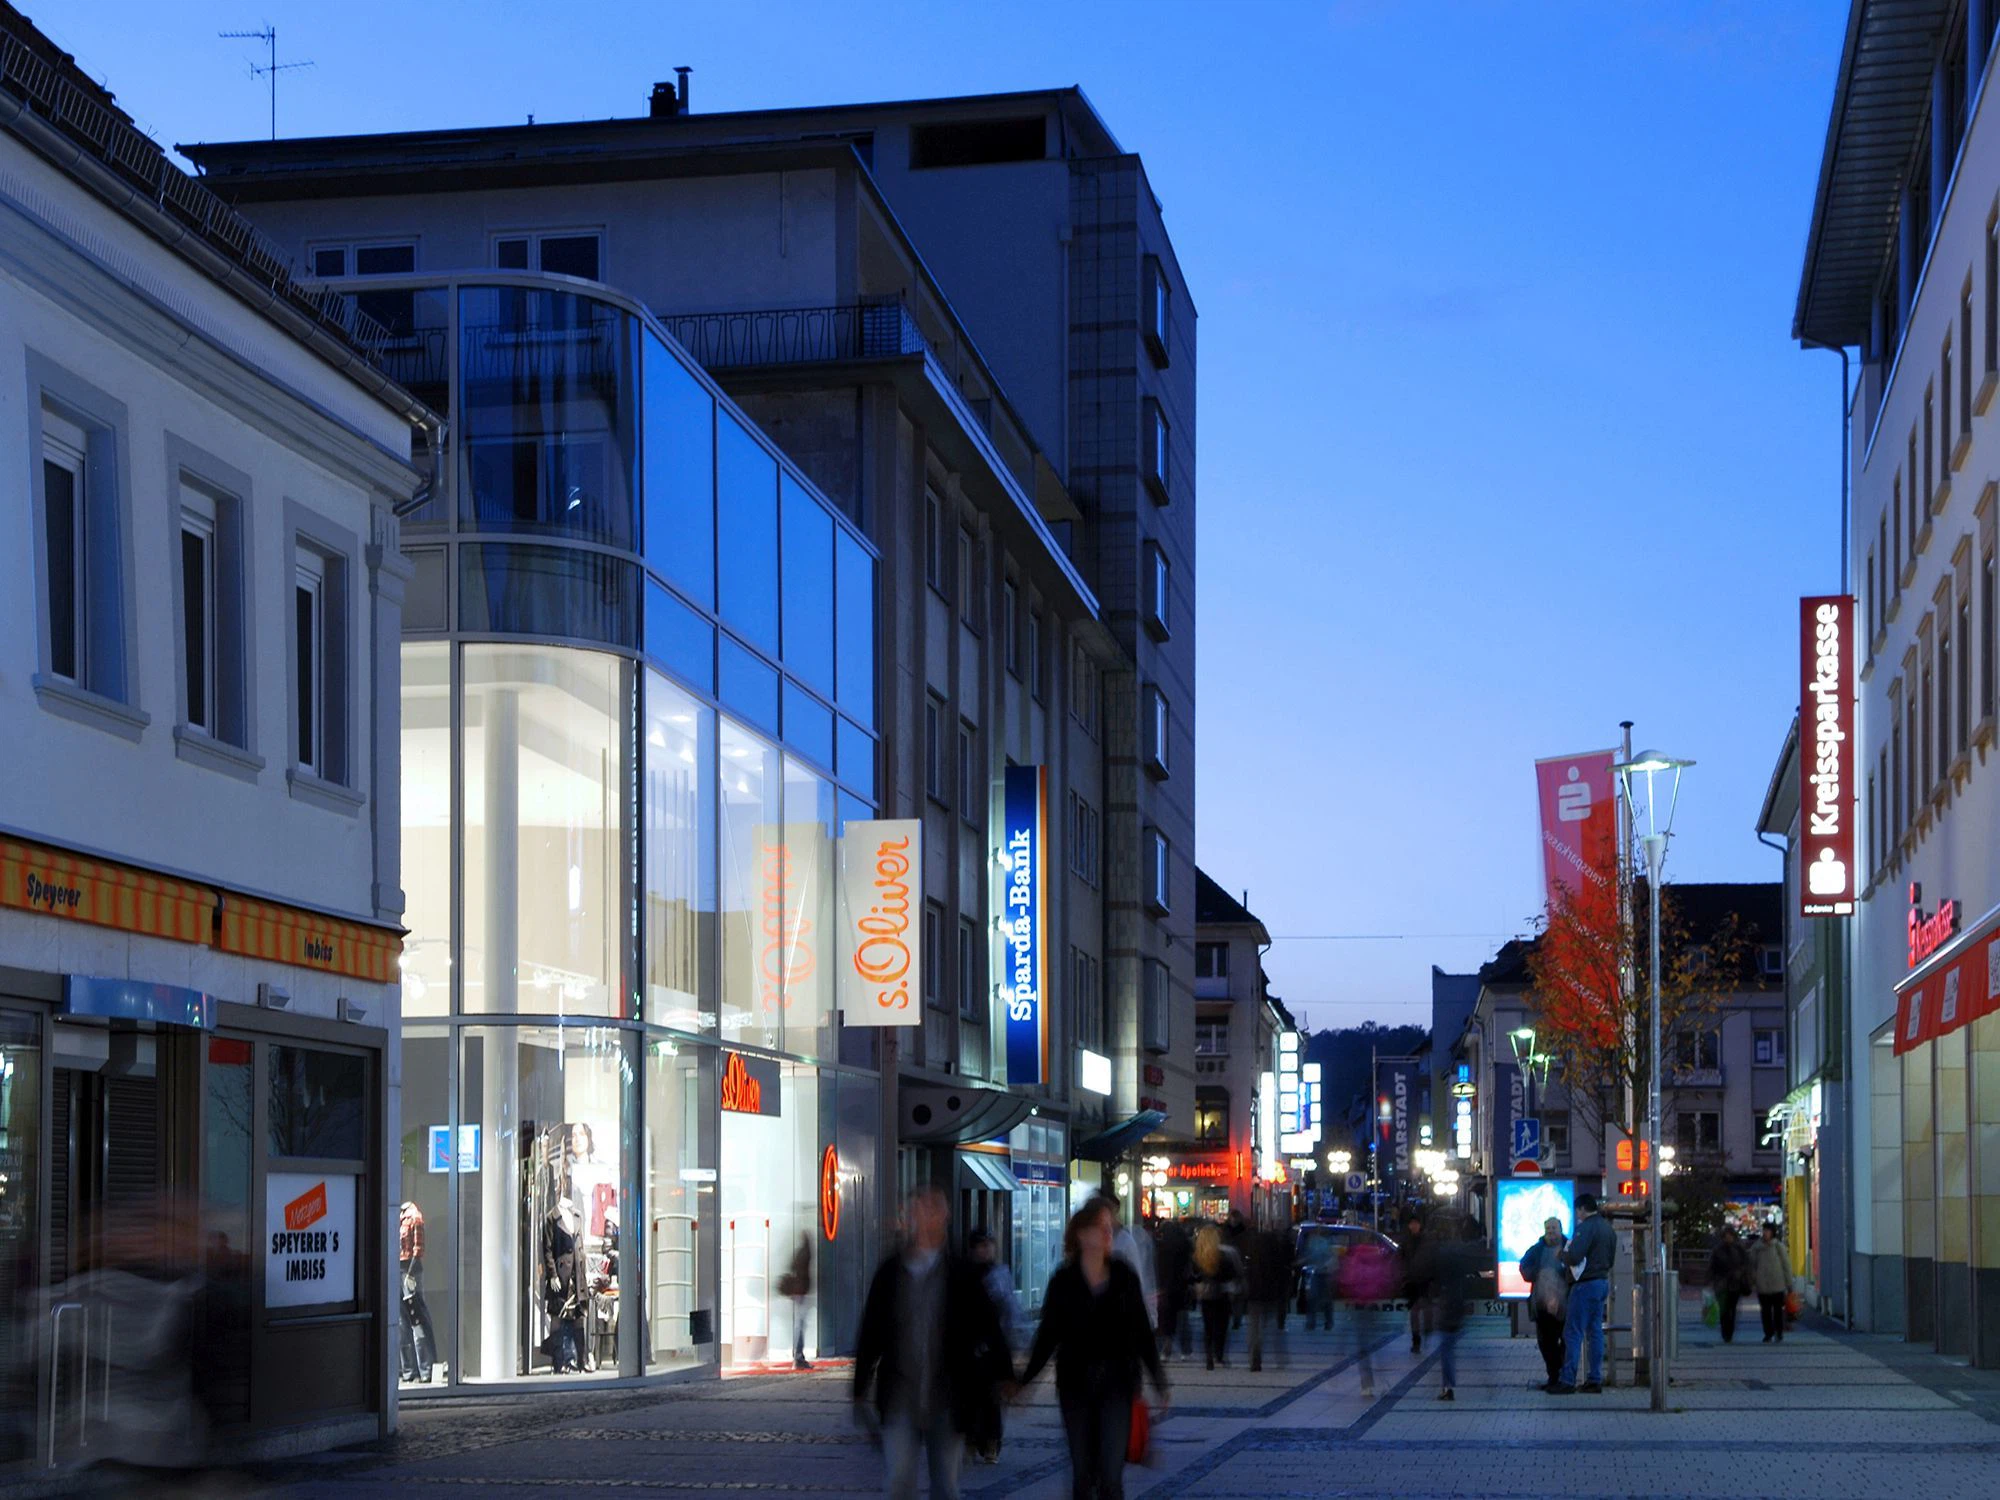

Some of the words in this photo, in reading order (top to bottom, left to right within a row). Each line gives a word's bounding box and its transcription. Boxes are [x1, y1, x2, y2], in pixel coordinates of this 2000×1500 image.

[1810, 603, 1845, 835] Kreissparkasse
[26, 873, 81, 911] Speyerer
[853, 835, 911, 1009] s.Oliver
[1010, 828, 1037, 1021] Sparda-Bank
[304, 936, 333, 963] Imbiss
[722, 1051, 761, 1114] s.Oliver
[1395, 1072, 1408, 1170] KARSTADT
[285, 1259, 326, 1282] IMBISS
